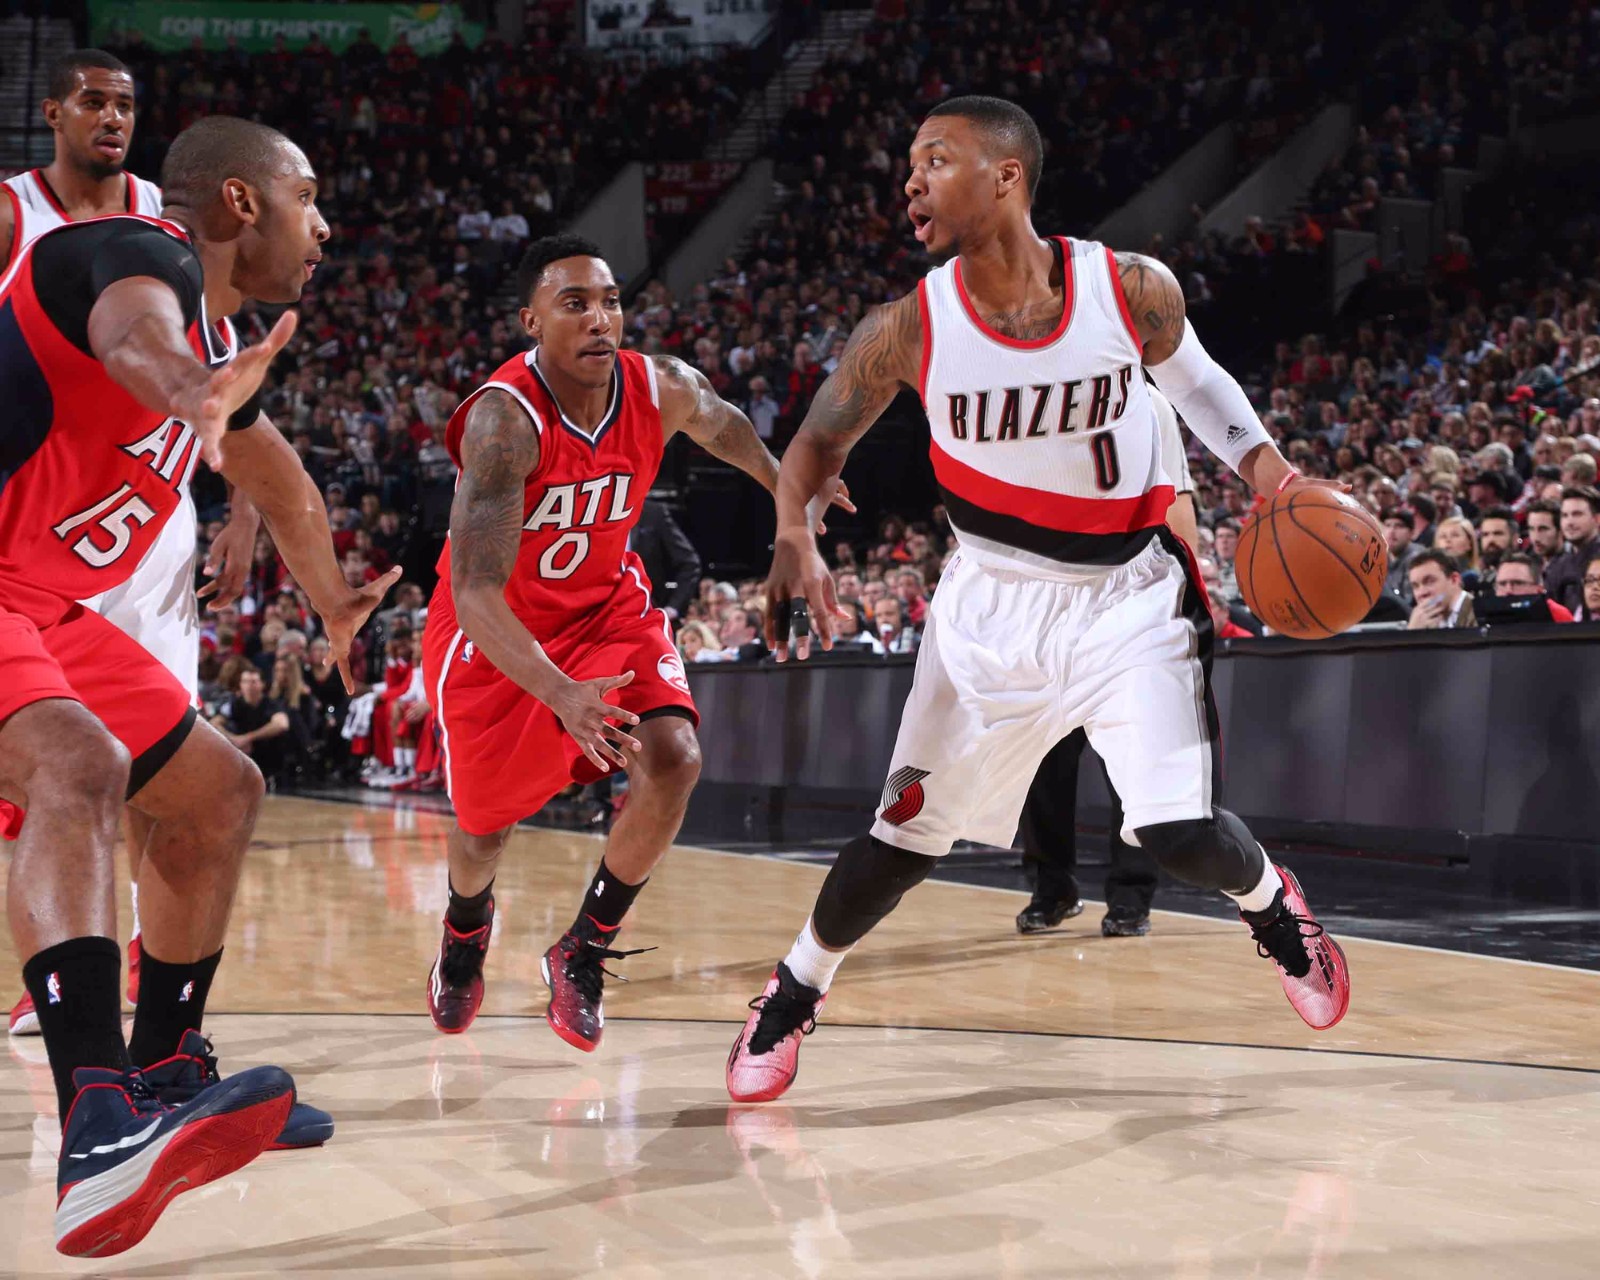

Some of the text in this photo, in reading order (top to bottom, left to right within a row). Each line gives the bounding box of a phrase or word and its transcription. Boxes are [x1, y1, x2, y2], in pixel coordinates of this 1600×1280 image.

[160, 17, 206, 36] FOR
[209, 18, 255, 37] THE
[945, 365, 1132, 443] BLAZERS
[1089, 431, 1121, 491] 0
[51, 480, 157, 569] 15
[522, 472, 634, 531] ATL
[538, 531, 591, 580] 0
